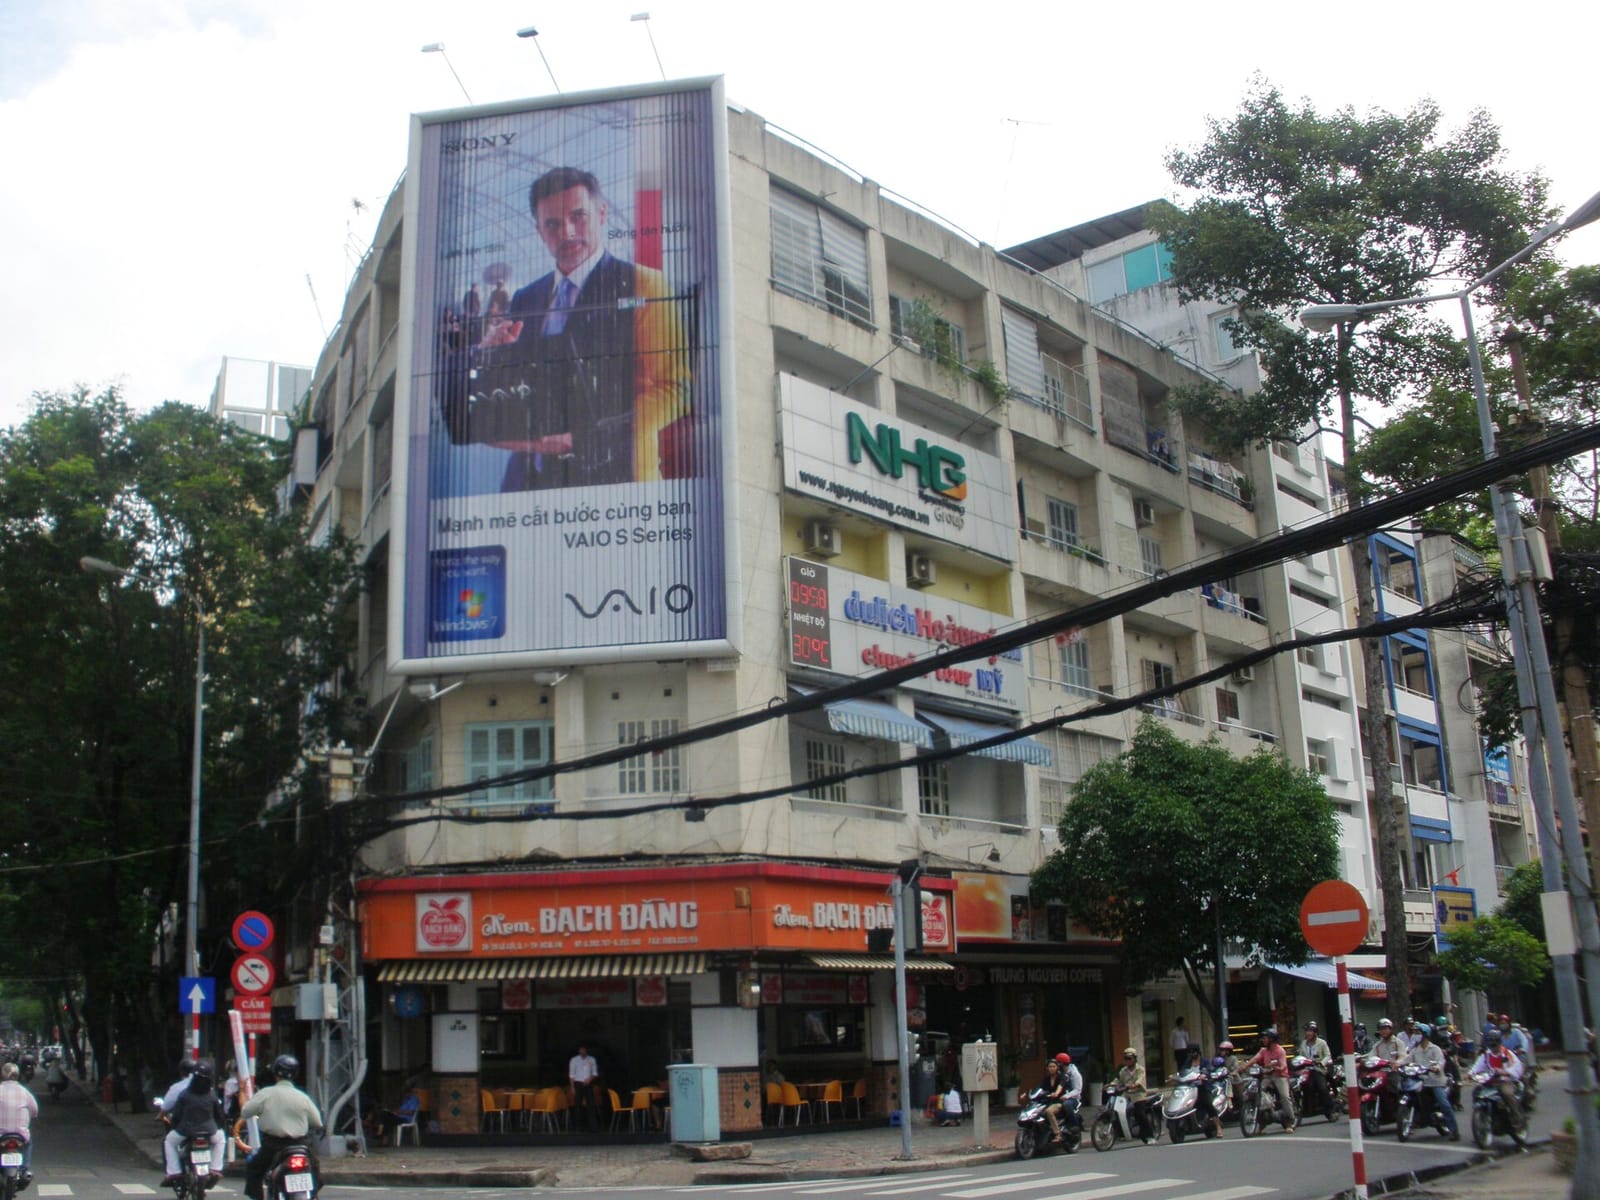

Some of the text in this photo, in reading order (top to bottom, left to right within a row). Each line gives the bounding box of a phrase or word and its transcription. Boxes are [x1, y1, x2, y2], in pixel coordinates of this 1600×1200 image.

[445, 132, 517, 153] SONY
[847, 411, 967, 499] NHG
[438, 514, 484, 536] Mạnh
[554, 501, 601, 525] bước
[605, 502, 652, 522] cùng
[934, 507, 965, 531] Group
[564, 525, 693, 549] VAIO S Series
[565, 583, 694, 619] VAIO
[539, 904, 612, 937] BẠCH
[813, 902, 860, 932] BẠCH
[989, 967, 1025, 983] TRUNG
[1070, 968, 1104, 984] COFFEE
